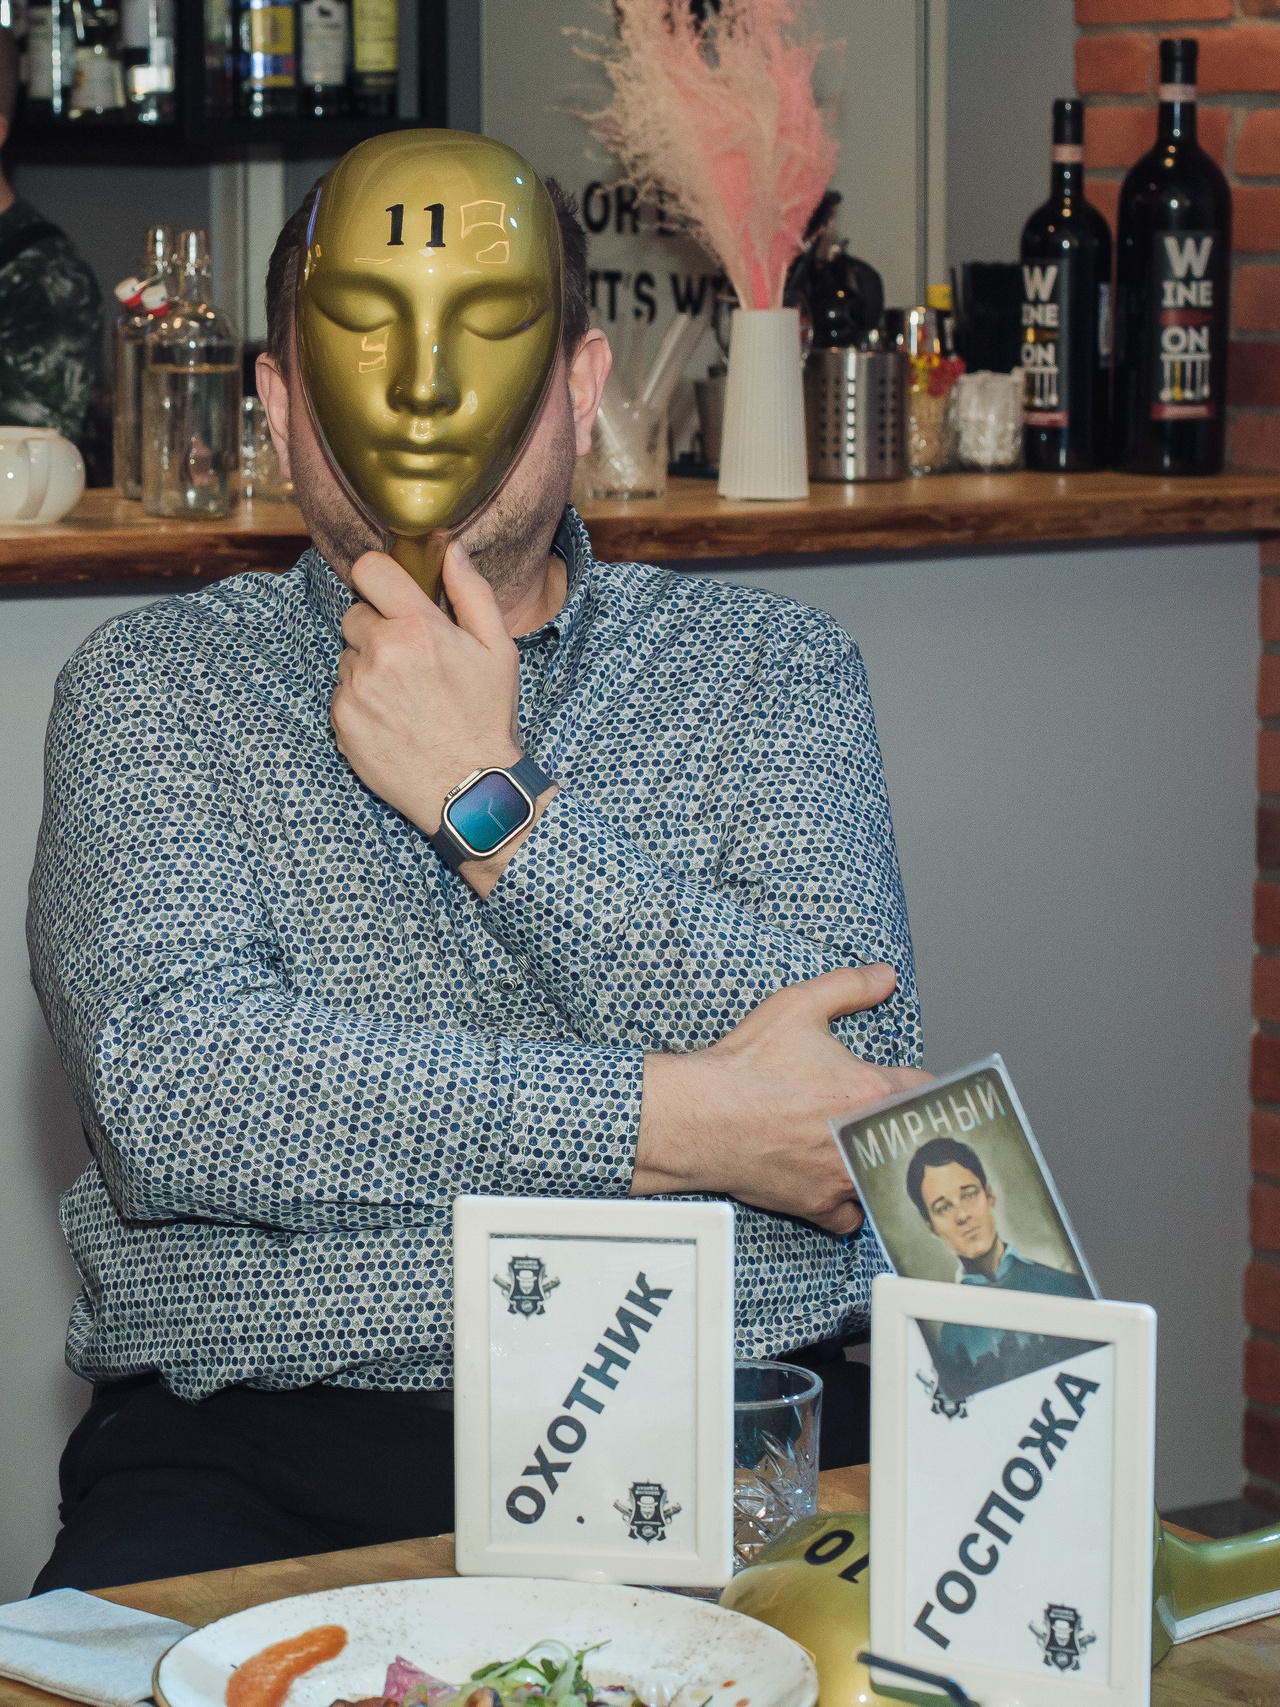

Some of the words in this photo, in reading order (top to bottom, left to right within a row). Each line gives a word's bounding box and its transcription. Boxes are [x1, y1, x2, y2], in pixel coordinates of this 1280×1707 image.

[385, 203, 446, 247] 11
[1161, 326, 1210, 353] ON
[852, 1076, 1006, 1171] МИРНЫЙ
[505, 1270, 674, 1525] ОХОТНИК
[914, 1371, 1101, 1651] ГОСПОЖА
